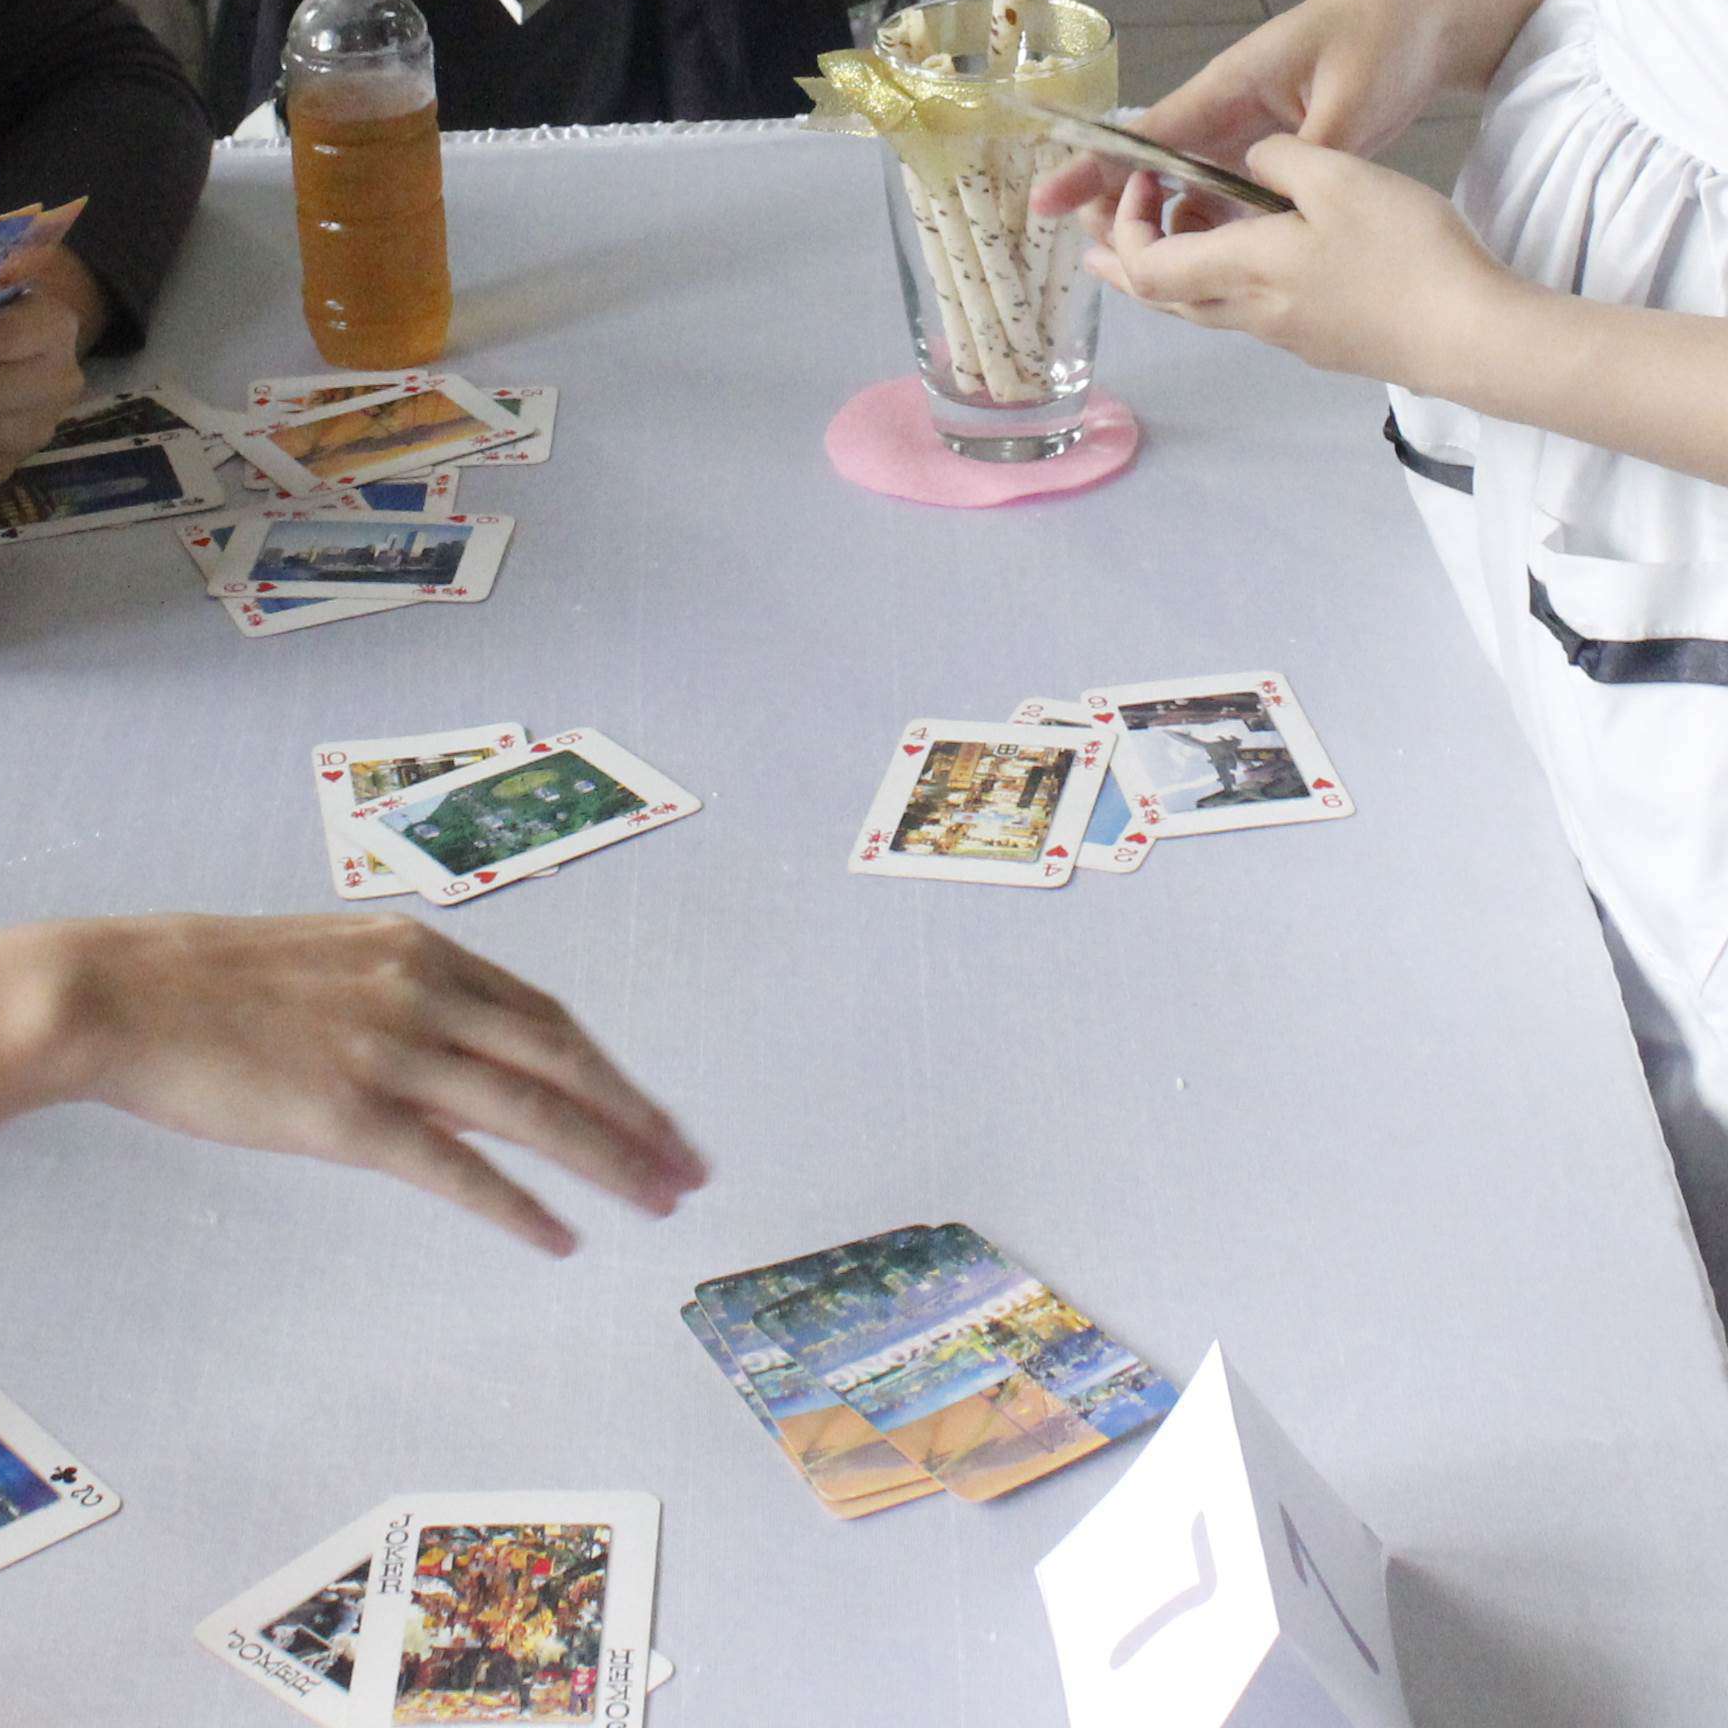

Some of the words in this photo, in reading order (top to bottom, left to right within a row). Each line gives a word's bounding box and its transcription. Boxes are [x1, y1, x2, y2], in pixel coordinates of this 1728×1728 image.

[223, 582, 249, 594] 6
[1086, 694, 1109, 710] 9
[1022, 704, 1045, 718] 2
[909, 726, 929, 741] 4
[317, 751, 348, 767] 10
[70, 1484, 104, 1508] 2
[378, 1512, 415, 1594] JOKER
[226, 1628, 323, 1698] JOKER
